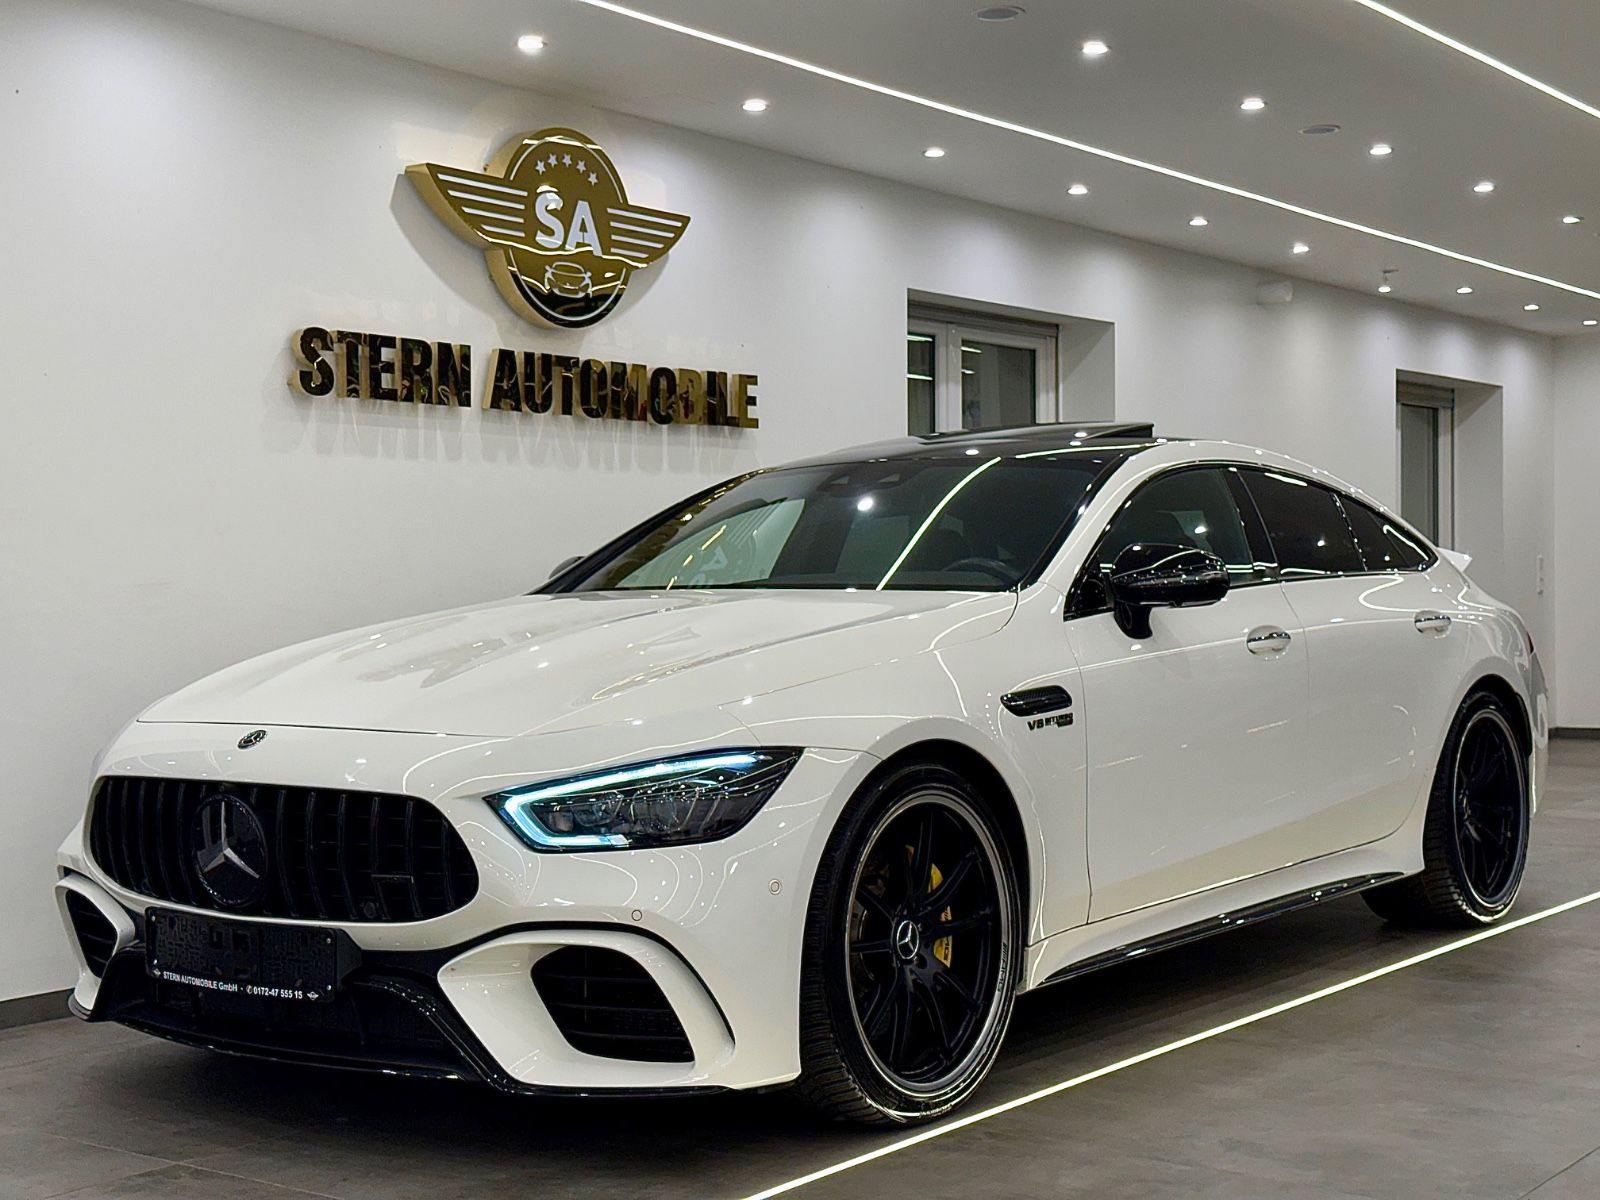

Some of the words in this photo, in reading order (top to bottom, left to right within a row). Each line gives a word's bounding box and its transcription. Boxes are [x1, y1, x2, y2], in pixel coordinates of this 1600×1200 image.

[535, 190, 603, 257] SA
[296, 326, 472, 408] STERN
[486, 347, 760, 430] AUTOMOBILE
[1026, 718, 1045, 731] V8
[162, 970, 181, 982] STERN
[181, 974, 218, 990] AUTOMOBILE
[218, 981, 238, 992] GmbH
[253, 986, 279, 997] 0172-47
[280, 988, 293, 999] 555
[294, 990, 303, 999] 15
